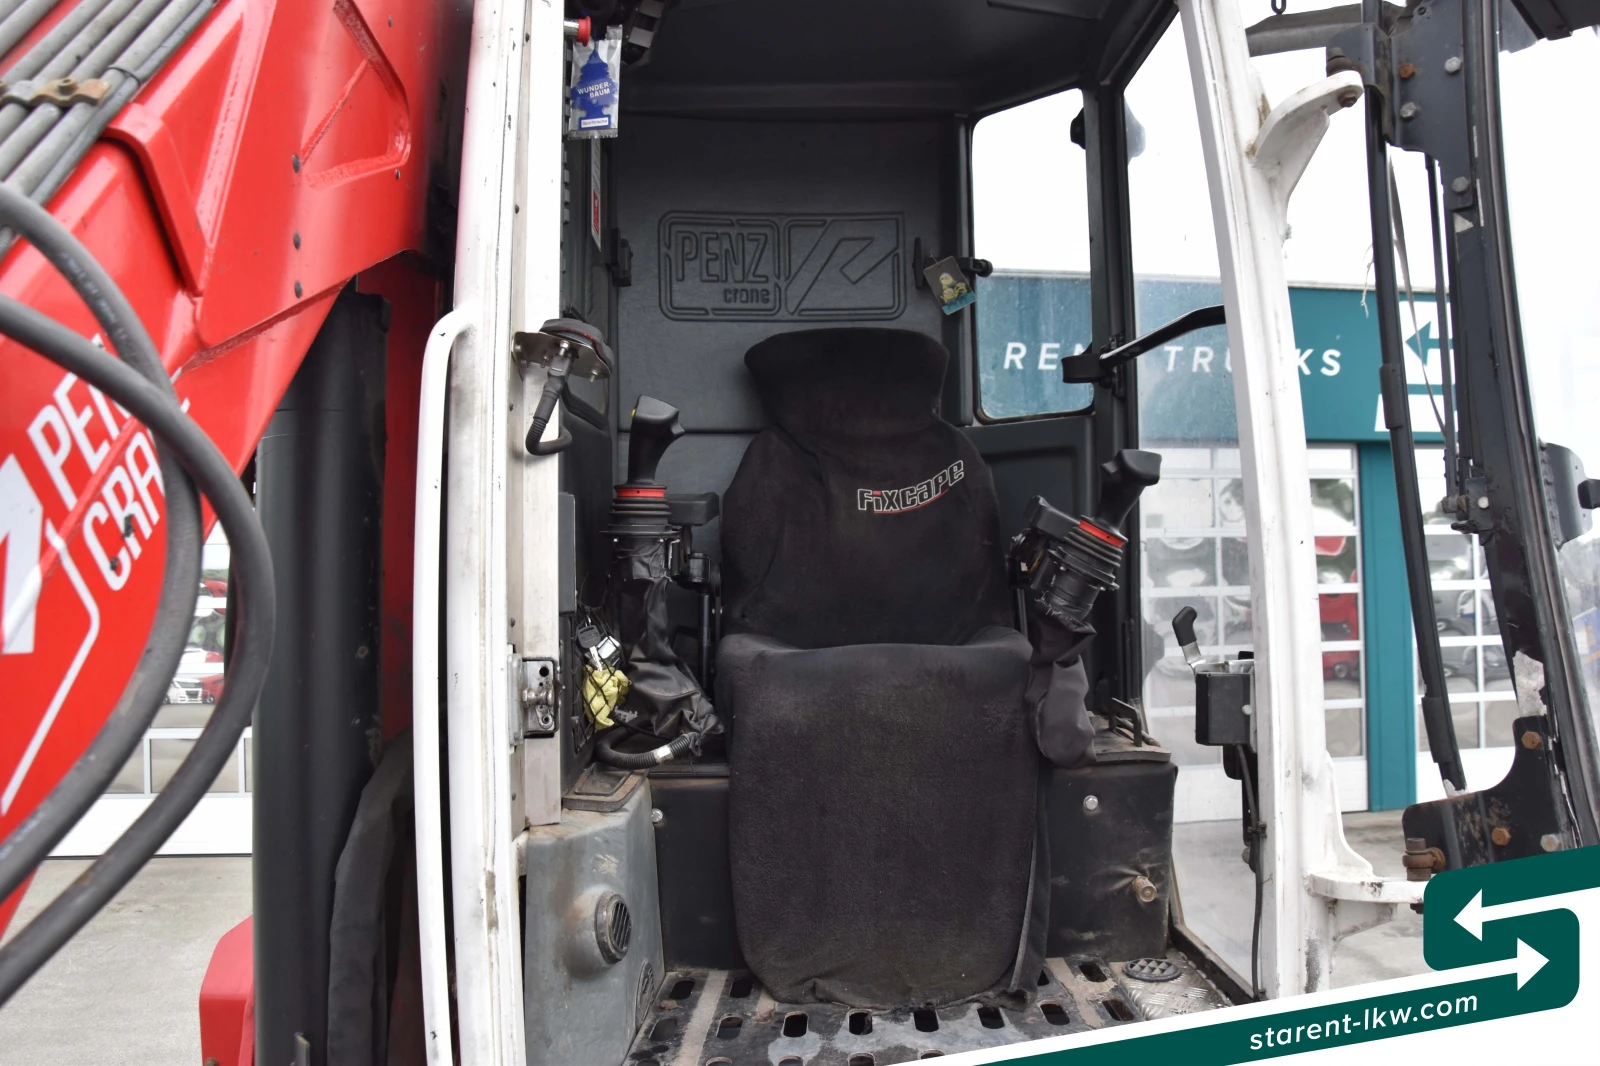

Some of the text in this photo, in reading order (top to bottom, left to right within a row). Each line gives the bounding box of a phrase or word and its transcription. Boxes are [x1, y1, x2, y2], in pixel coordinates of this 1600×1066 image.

[577, 81, 612, 95] WUNDER-
[589, 88, 611, 98] BAUM
[675, 230, 769, 284] PENZ
[723, 287, 770, 305] crane
[1003, 341, 1342, 376] RE TRKS
[83, 388, 187, 591] CRA
